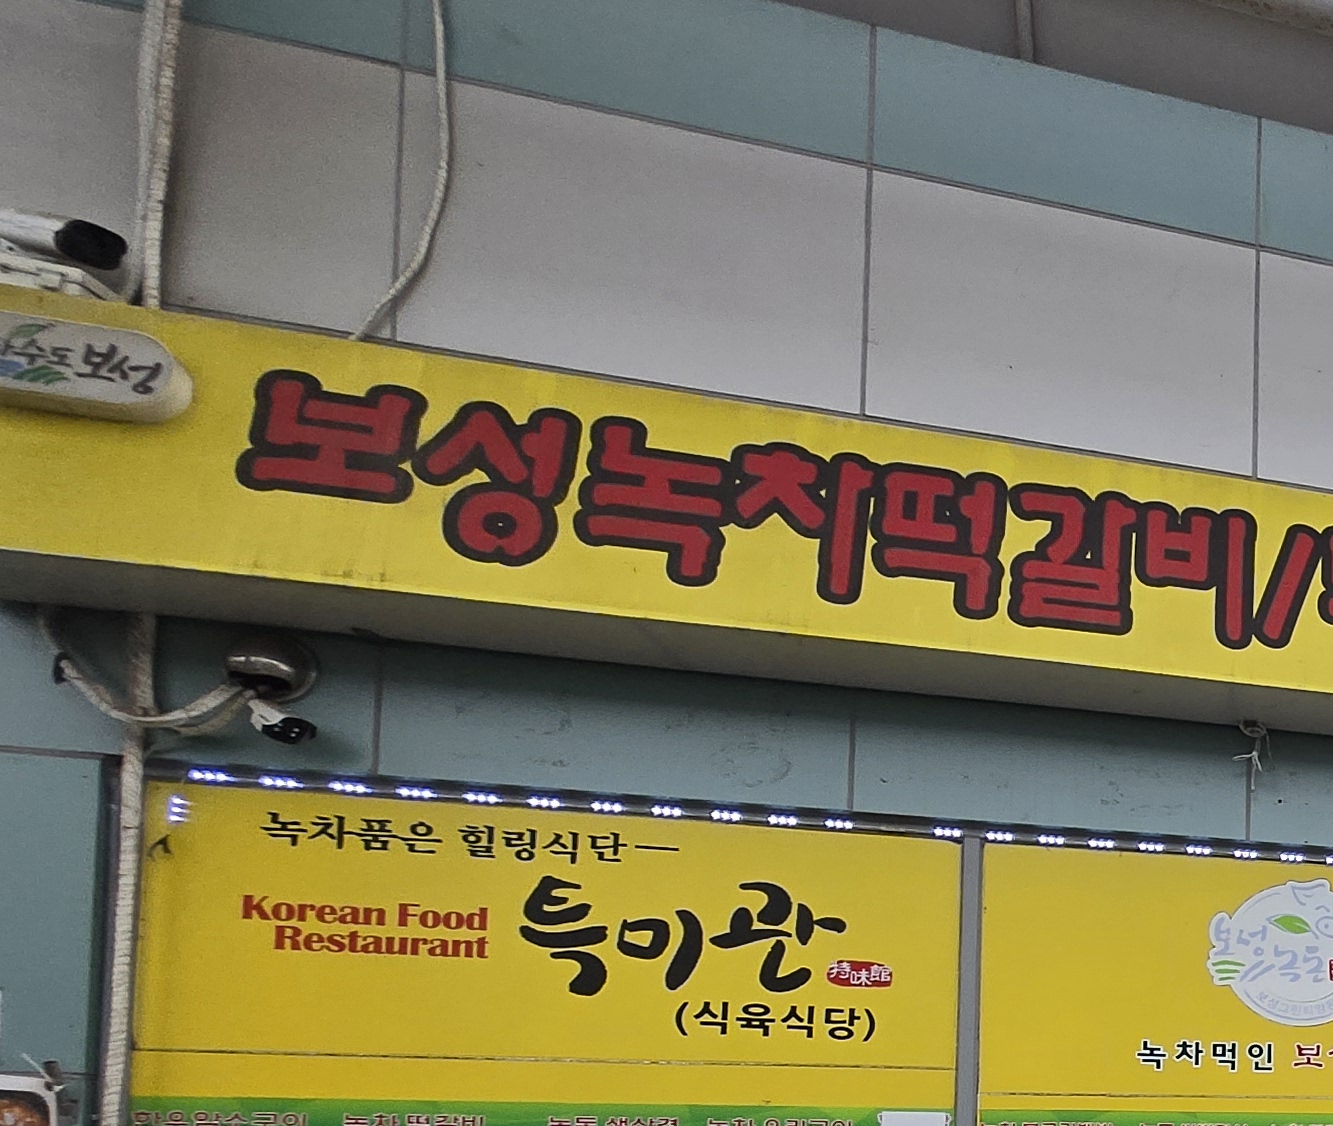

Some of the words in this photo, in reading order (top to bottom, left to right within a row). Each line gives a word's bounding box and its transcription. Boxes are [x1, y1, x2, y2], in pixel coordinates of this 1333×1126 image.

[74, 342, 163, 395] 보성
[261, 811, 443, 855] 녹차품은
[241, 894, 377, 926] Korean
[397, 902, 489, 932] Food
[273, 925, 489, 960] Restaurant
[519, 875, 847, 996] 특미관
[675, 1001, 877, 1043] (식육식당)
[1136, 1040, 1275, 1072] 녹차먹인
